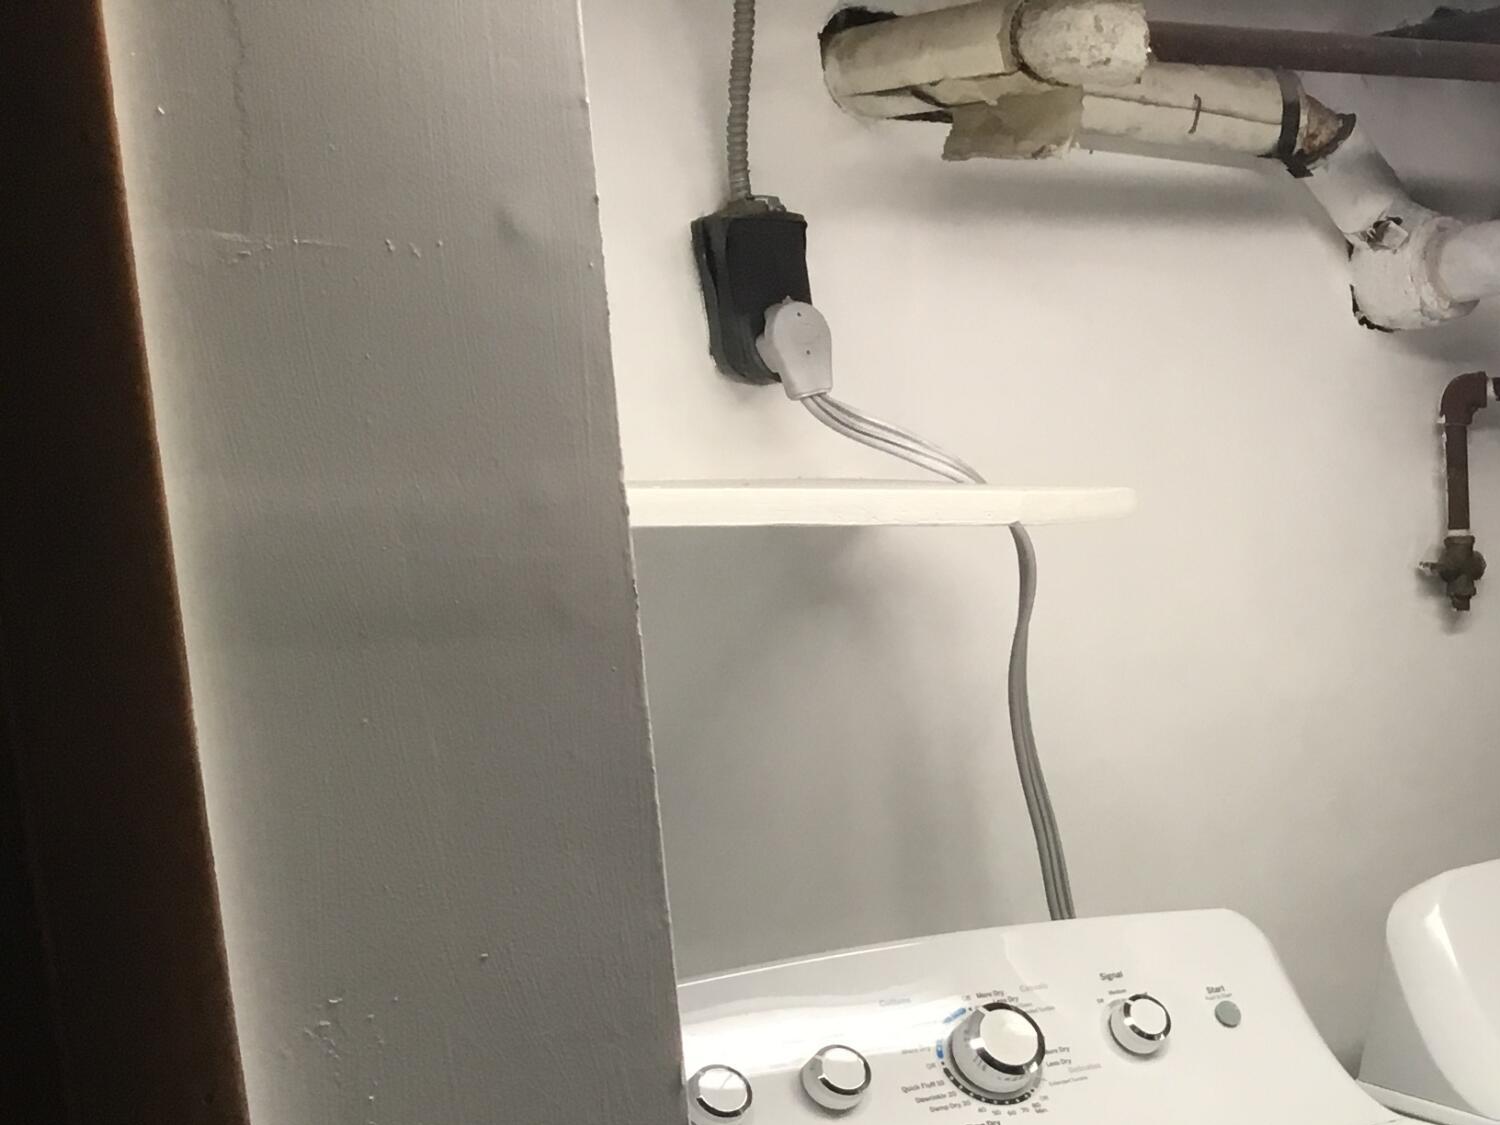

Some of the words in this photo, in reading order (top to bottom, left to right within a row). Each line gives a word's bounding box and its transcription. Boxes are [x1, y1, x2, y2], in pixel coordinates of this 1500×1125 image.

[1099, 971, 1123, 981] Signal
[976, 991, 992, 999] More
[992, 989, 1005, 998] Dry
[1206, 986, 1225, 994] Start
[901, 1084, 920, 1093] Quick
[921, 1080, 936, 1089] Fluff
[929, 1104, 949, 1112] Damp
[949, 1102, 962, 1110] Dry
